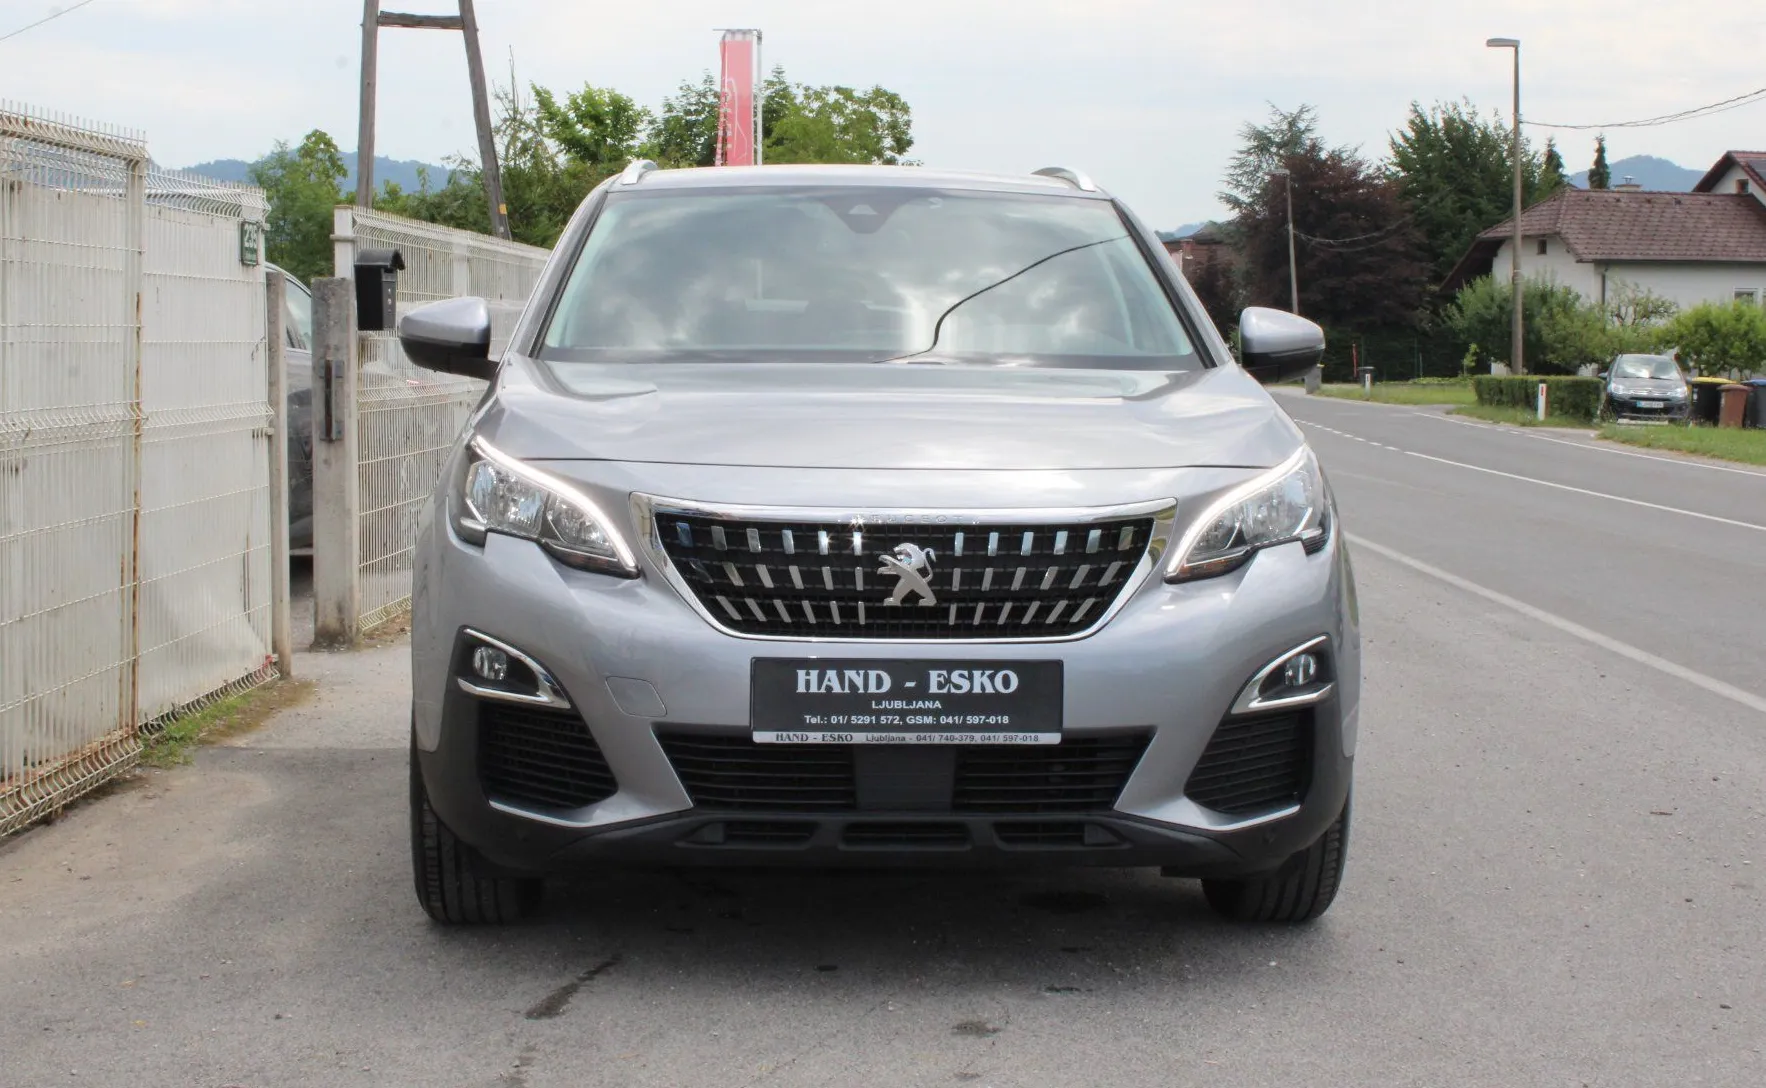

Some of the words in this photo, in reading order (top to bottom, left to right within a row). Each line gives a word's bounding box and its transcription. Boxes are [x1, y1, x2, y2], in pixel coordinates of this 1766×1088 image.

[796, 669, 892, 693] HAND
[928, 669, 1019, 694] ESKO
[871, 700, 942, 709] LJUBLJANA
[804, 715, 828, 724] Tel.:
[830, 715, 848, 725] 01/
[850, 715, 876, 724] 5291
[880, 715, 904, 726] 572,
[906, 715, 937, 724] GSM:
[940, 715, 963, 725] 041/
[966, 715, 1010, 724] 597-018
[775, 733, 809, 742] HAND
[821, 733, 854, 742] ESKO
[865, 734, 906, 743] Ljubljana
[916, 734, 936, 742] 041/
[980, 734, 1000, 743] 041/
[1003, 734, 1039, 743] 597-018
